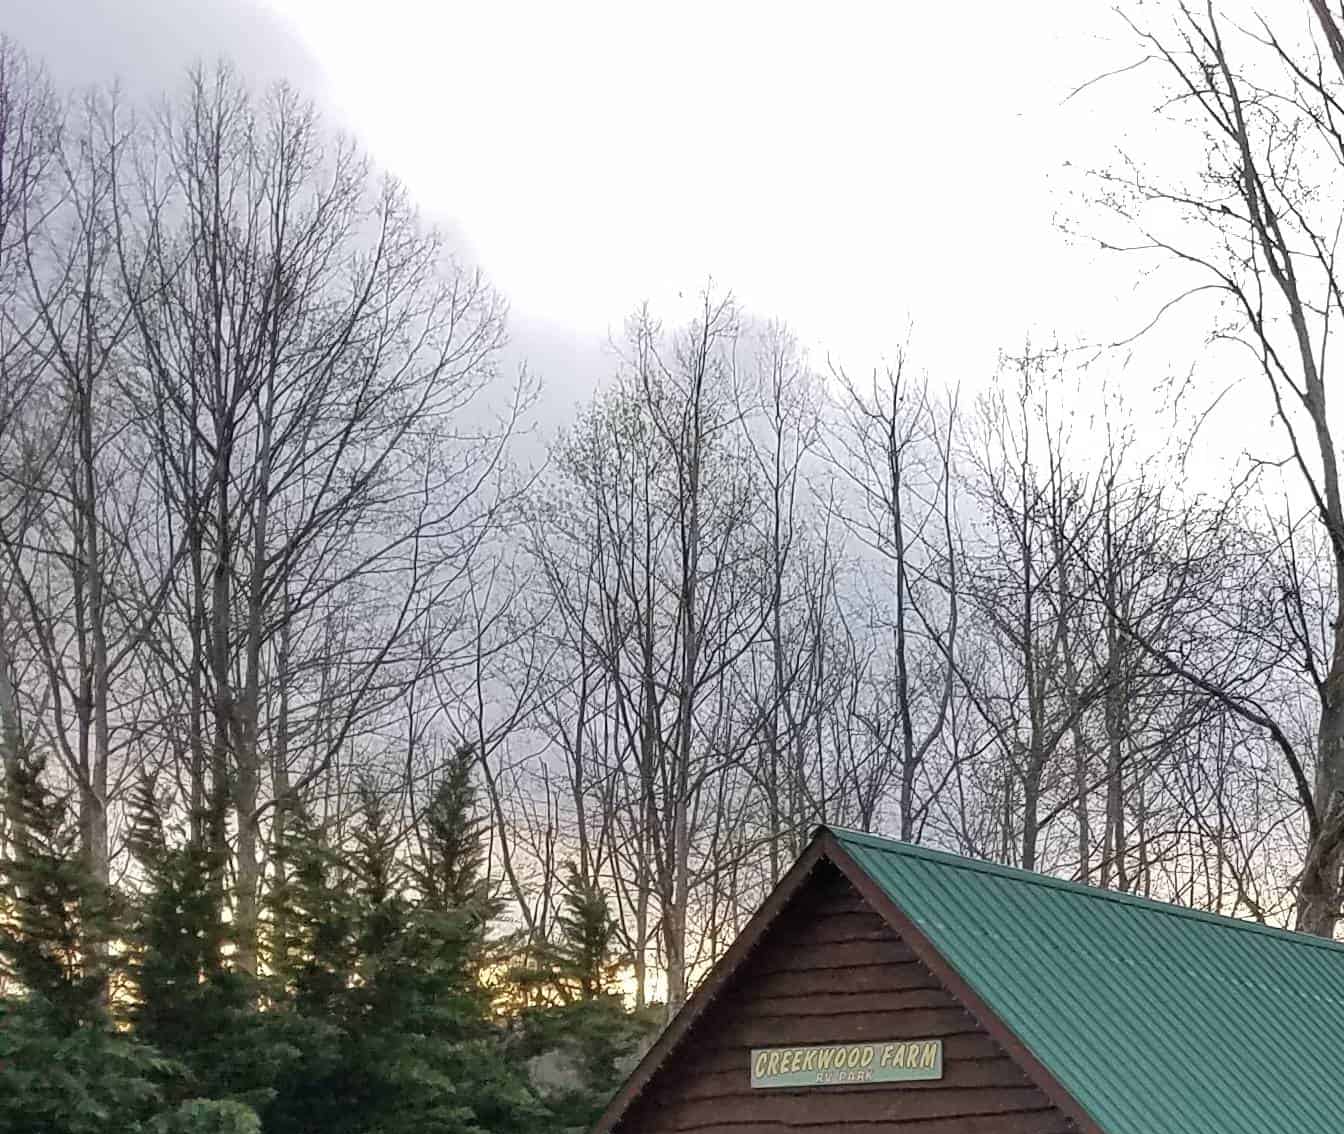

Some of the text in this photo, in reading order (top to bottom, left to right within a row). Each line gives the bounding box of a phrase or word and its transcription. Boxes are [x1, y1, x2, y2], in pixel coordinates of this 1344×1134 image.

[756, 1043, 938, 1078] CREEKWOOD FARM
[815, 1069, 873, 1083] RV PARK
